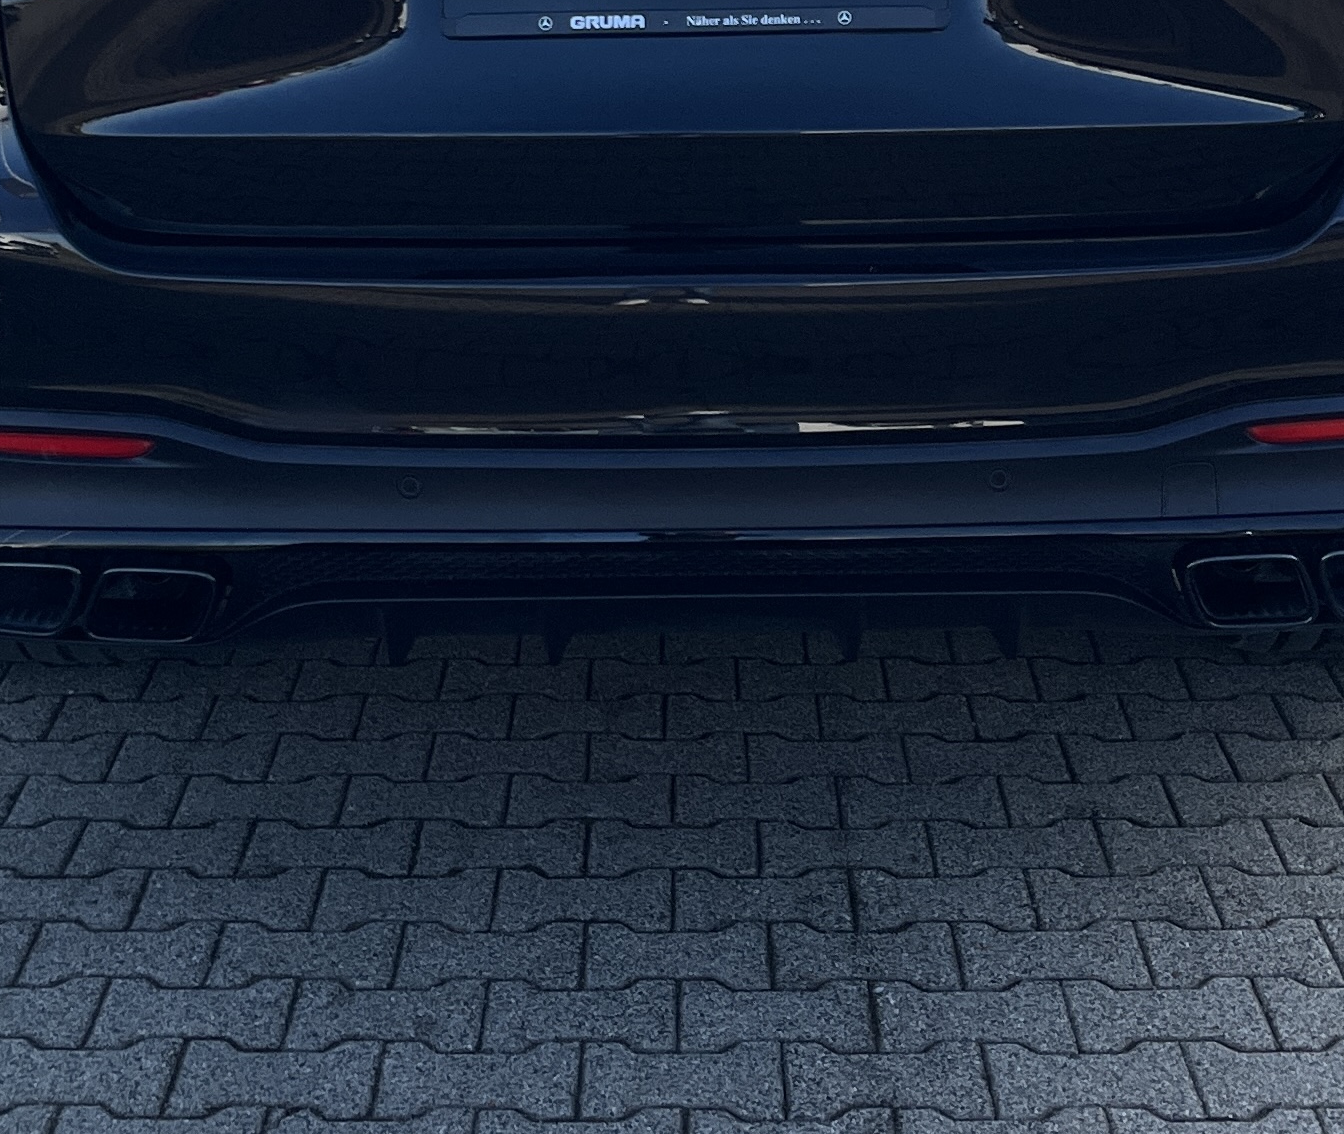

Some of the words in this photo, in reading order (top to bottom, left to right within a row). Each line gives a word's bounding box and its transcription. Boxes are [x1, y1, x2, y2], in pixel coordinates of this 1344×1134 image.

[570, 15, 645, 30] GRUMA
[686, 15, 721, 26] Näher
[722, 15, 739, 26] als
[741, 14, 758, 25] Sie
